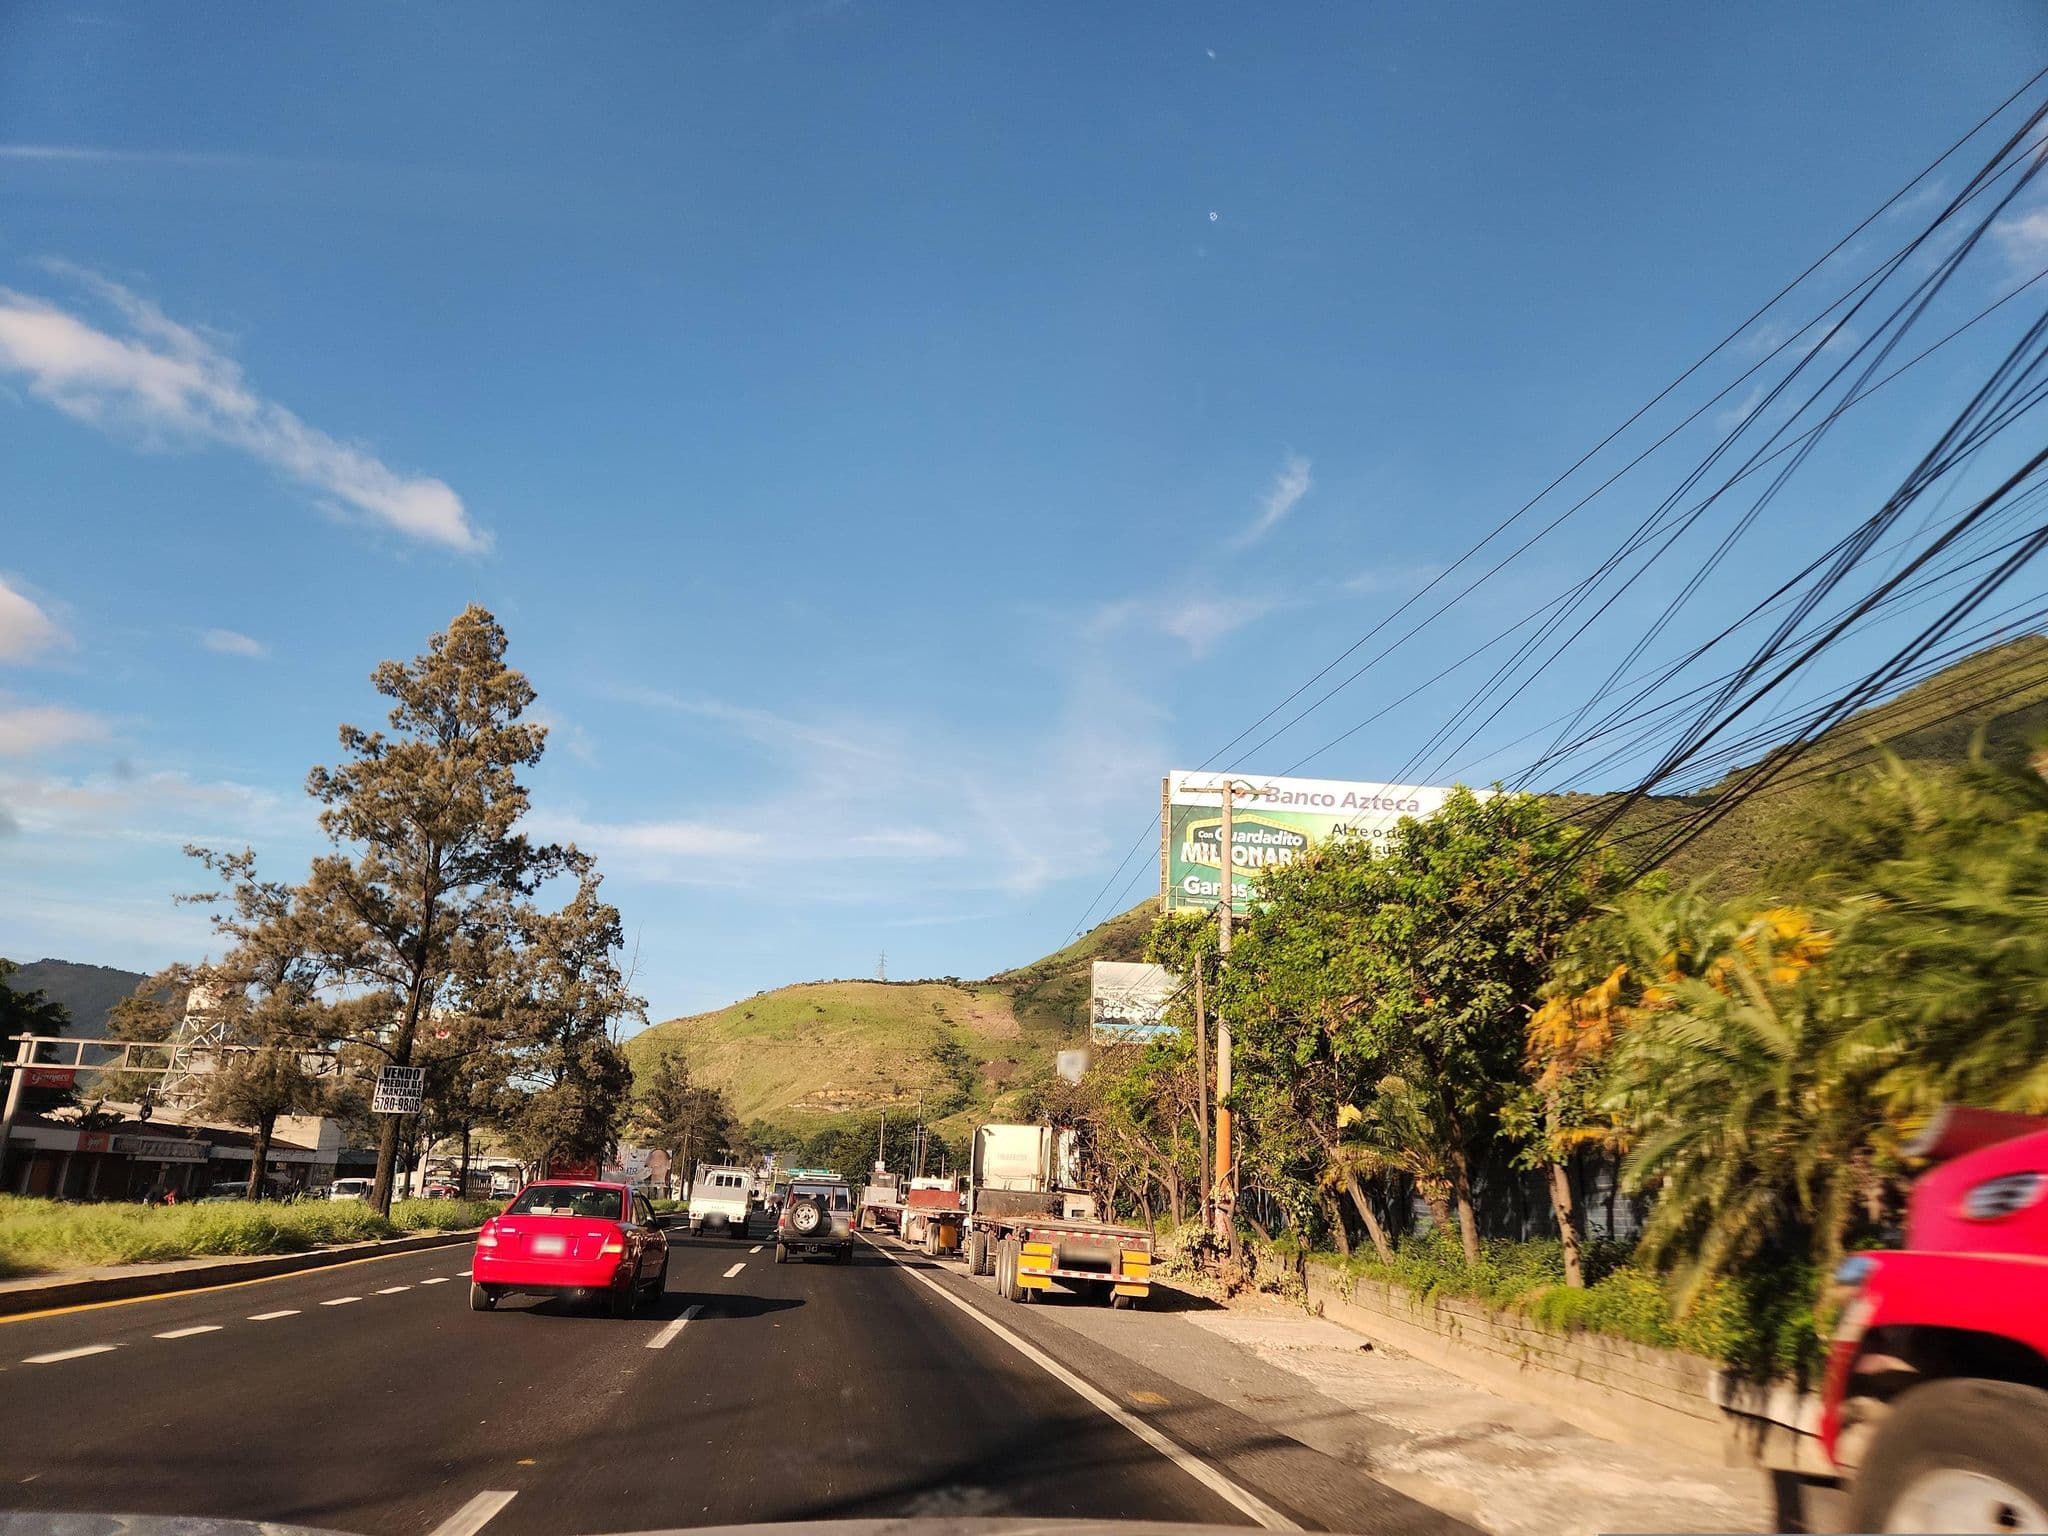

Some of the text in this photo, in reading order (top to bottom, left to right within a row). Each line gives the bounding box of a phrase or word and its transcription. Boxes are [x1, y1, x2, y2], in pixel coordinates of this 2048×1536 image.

[1264, 786, 1419, 812] Banco Azteca
[1198, 830, 1213, 839] Con
[1373, 829, 1382, 838] o
[1180, 841, 1311, 868] MILONAR
[383, 1067, 420, 1080] VENDO
[378, 1079, 422, 1090] PREDIO DE
[382, 1088, 421, 1098] MANZANAS
[374, 1097, 420, 1112] 5780-9806
